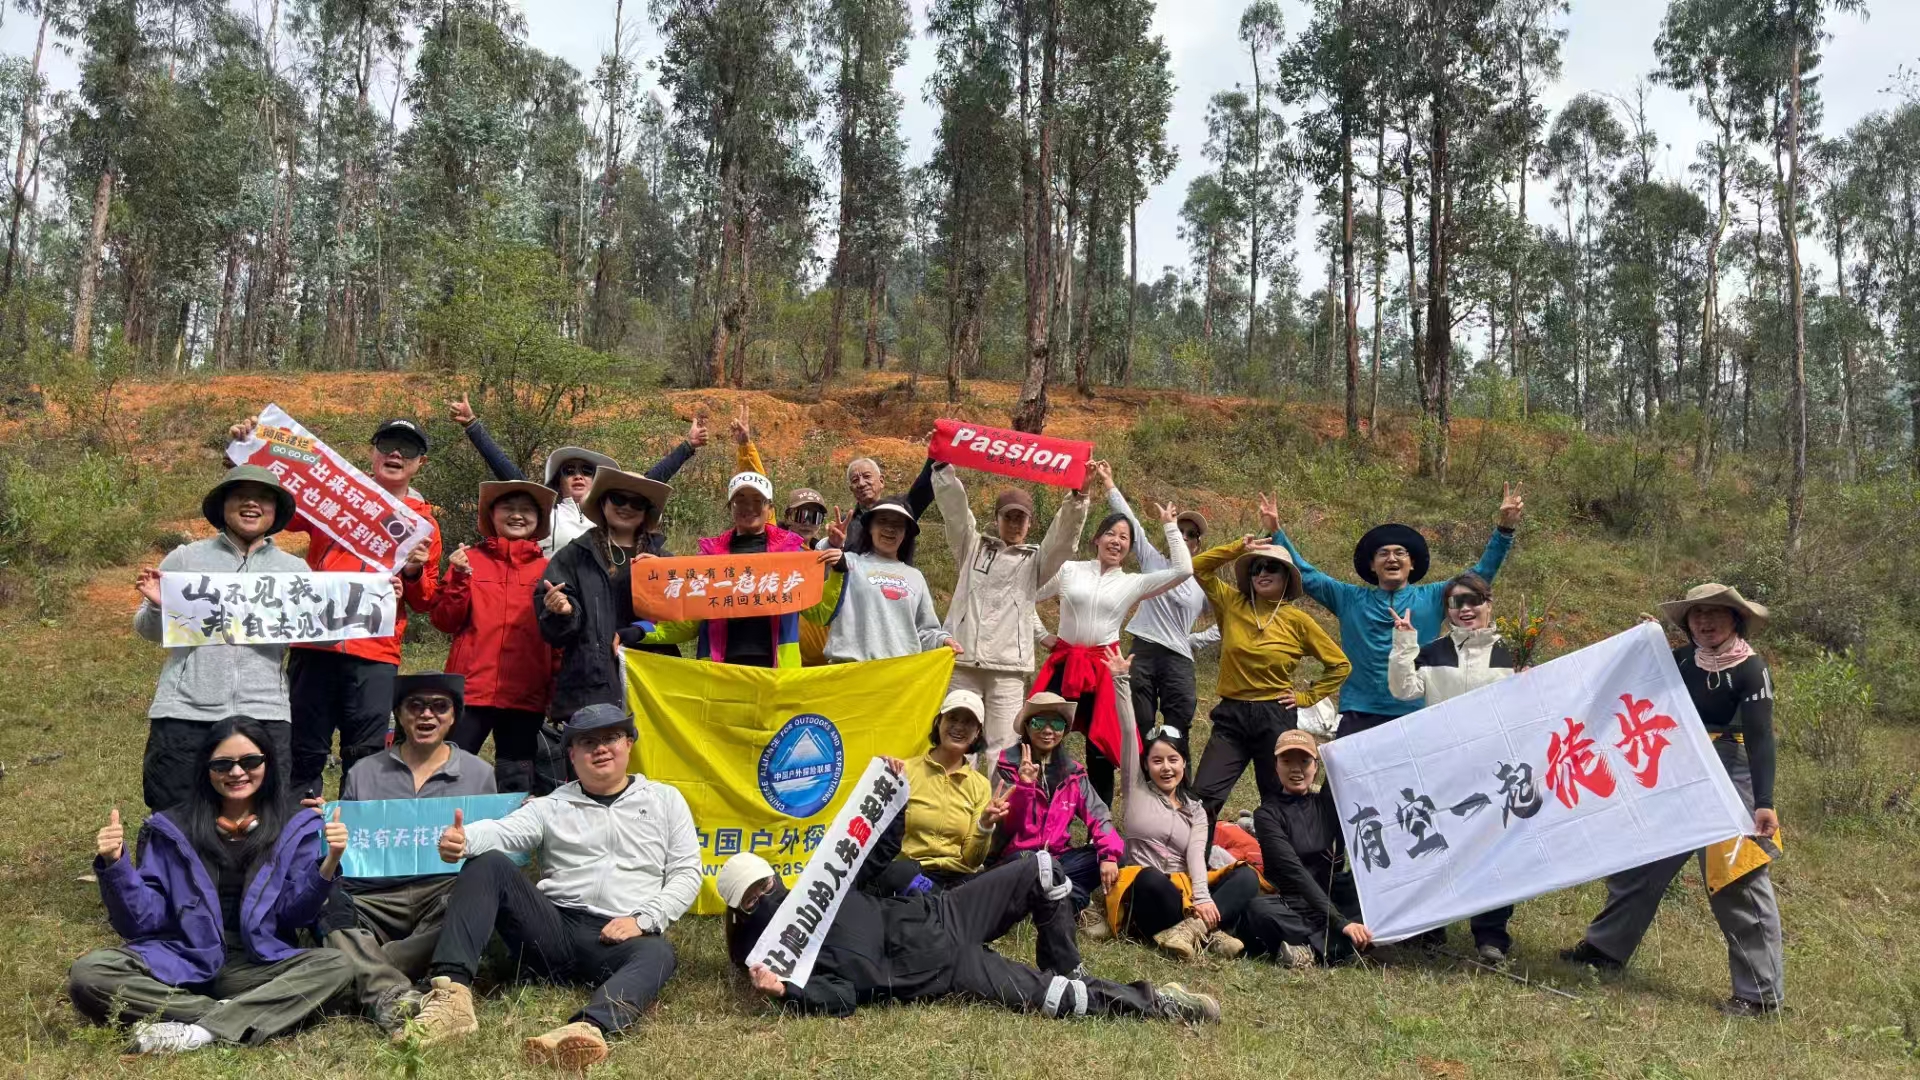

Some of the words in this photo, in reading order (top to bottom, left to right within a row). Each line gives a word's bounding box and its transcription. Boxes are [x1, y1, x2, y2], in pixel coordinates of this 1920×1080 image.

[273, 445, 286, 454] GO
[288, 450, 301, 458] GO
[303, 455, 316, 463] GO
[951, 428, 1073, 470] Passion
[308, 461, 386, 522] 出来玩啊
[267, 460, 393, 558] 反正也赚不到钱
[182, 575, 322, 608] 山不见我
[664, 570, 805, 599] 有空一起徒步
[780, 723, 793, 737] FOR
[794, 717, 832, 731] OUTDOORS
[830, 731, 840, 747] AND
[760, 738, 780, 777] ALLIANCE
[773, 763, 832, 782] 中国户外探险联盟
[822, 751, 842, 803] EXPEDITIONS
[1347, 693, 1681, 874] 有空一起徒步
[761, 780, 785, 811] CHINESE
